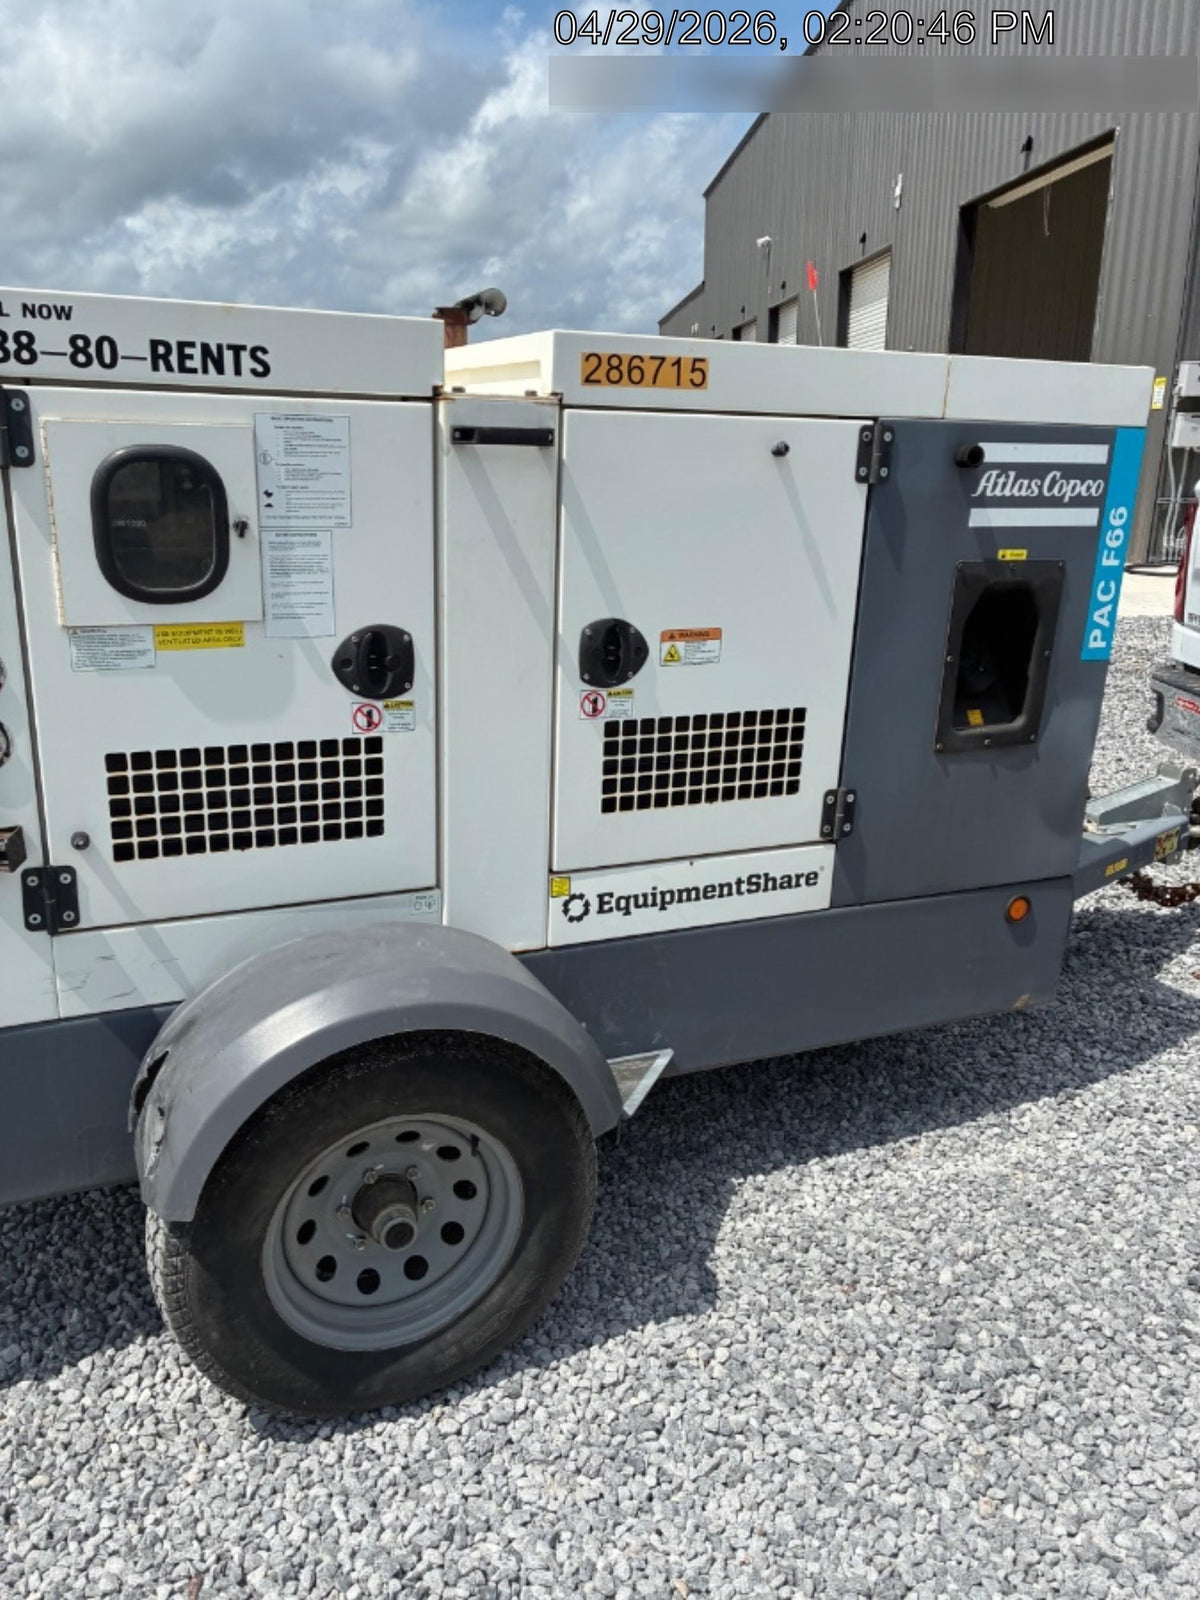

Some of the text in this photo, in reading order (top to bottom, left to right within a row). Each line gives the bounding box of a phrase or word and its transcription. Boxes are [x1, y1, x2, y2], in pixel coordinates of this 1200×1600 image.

[21, 302, 73, 321] NOW
[584, 353, 707, 387] 286715
[970, 469, 1105, 503] Atlas Copco
[1088, 506, 1128, 649] PAC F66
[596, 870, 819, 916] EquipmentShare
